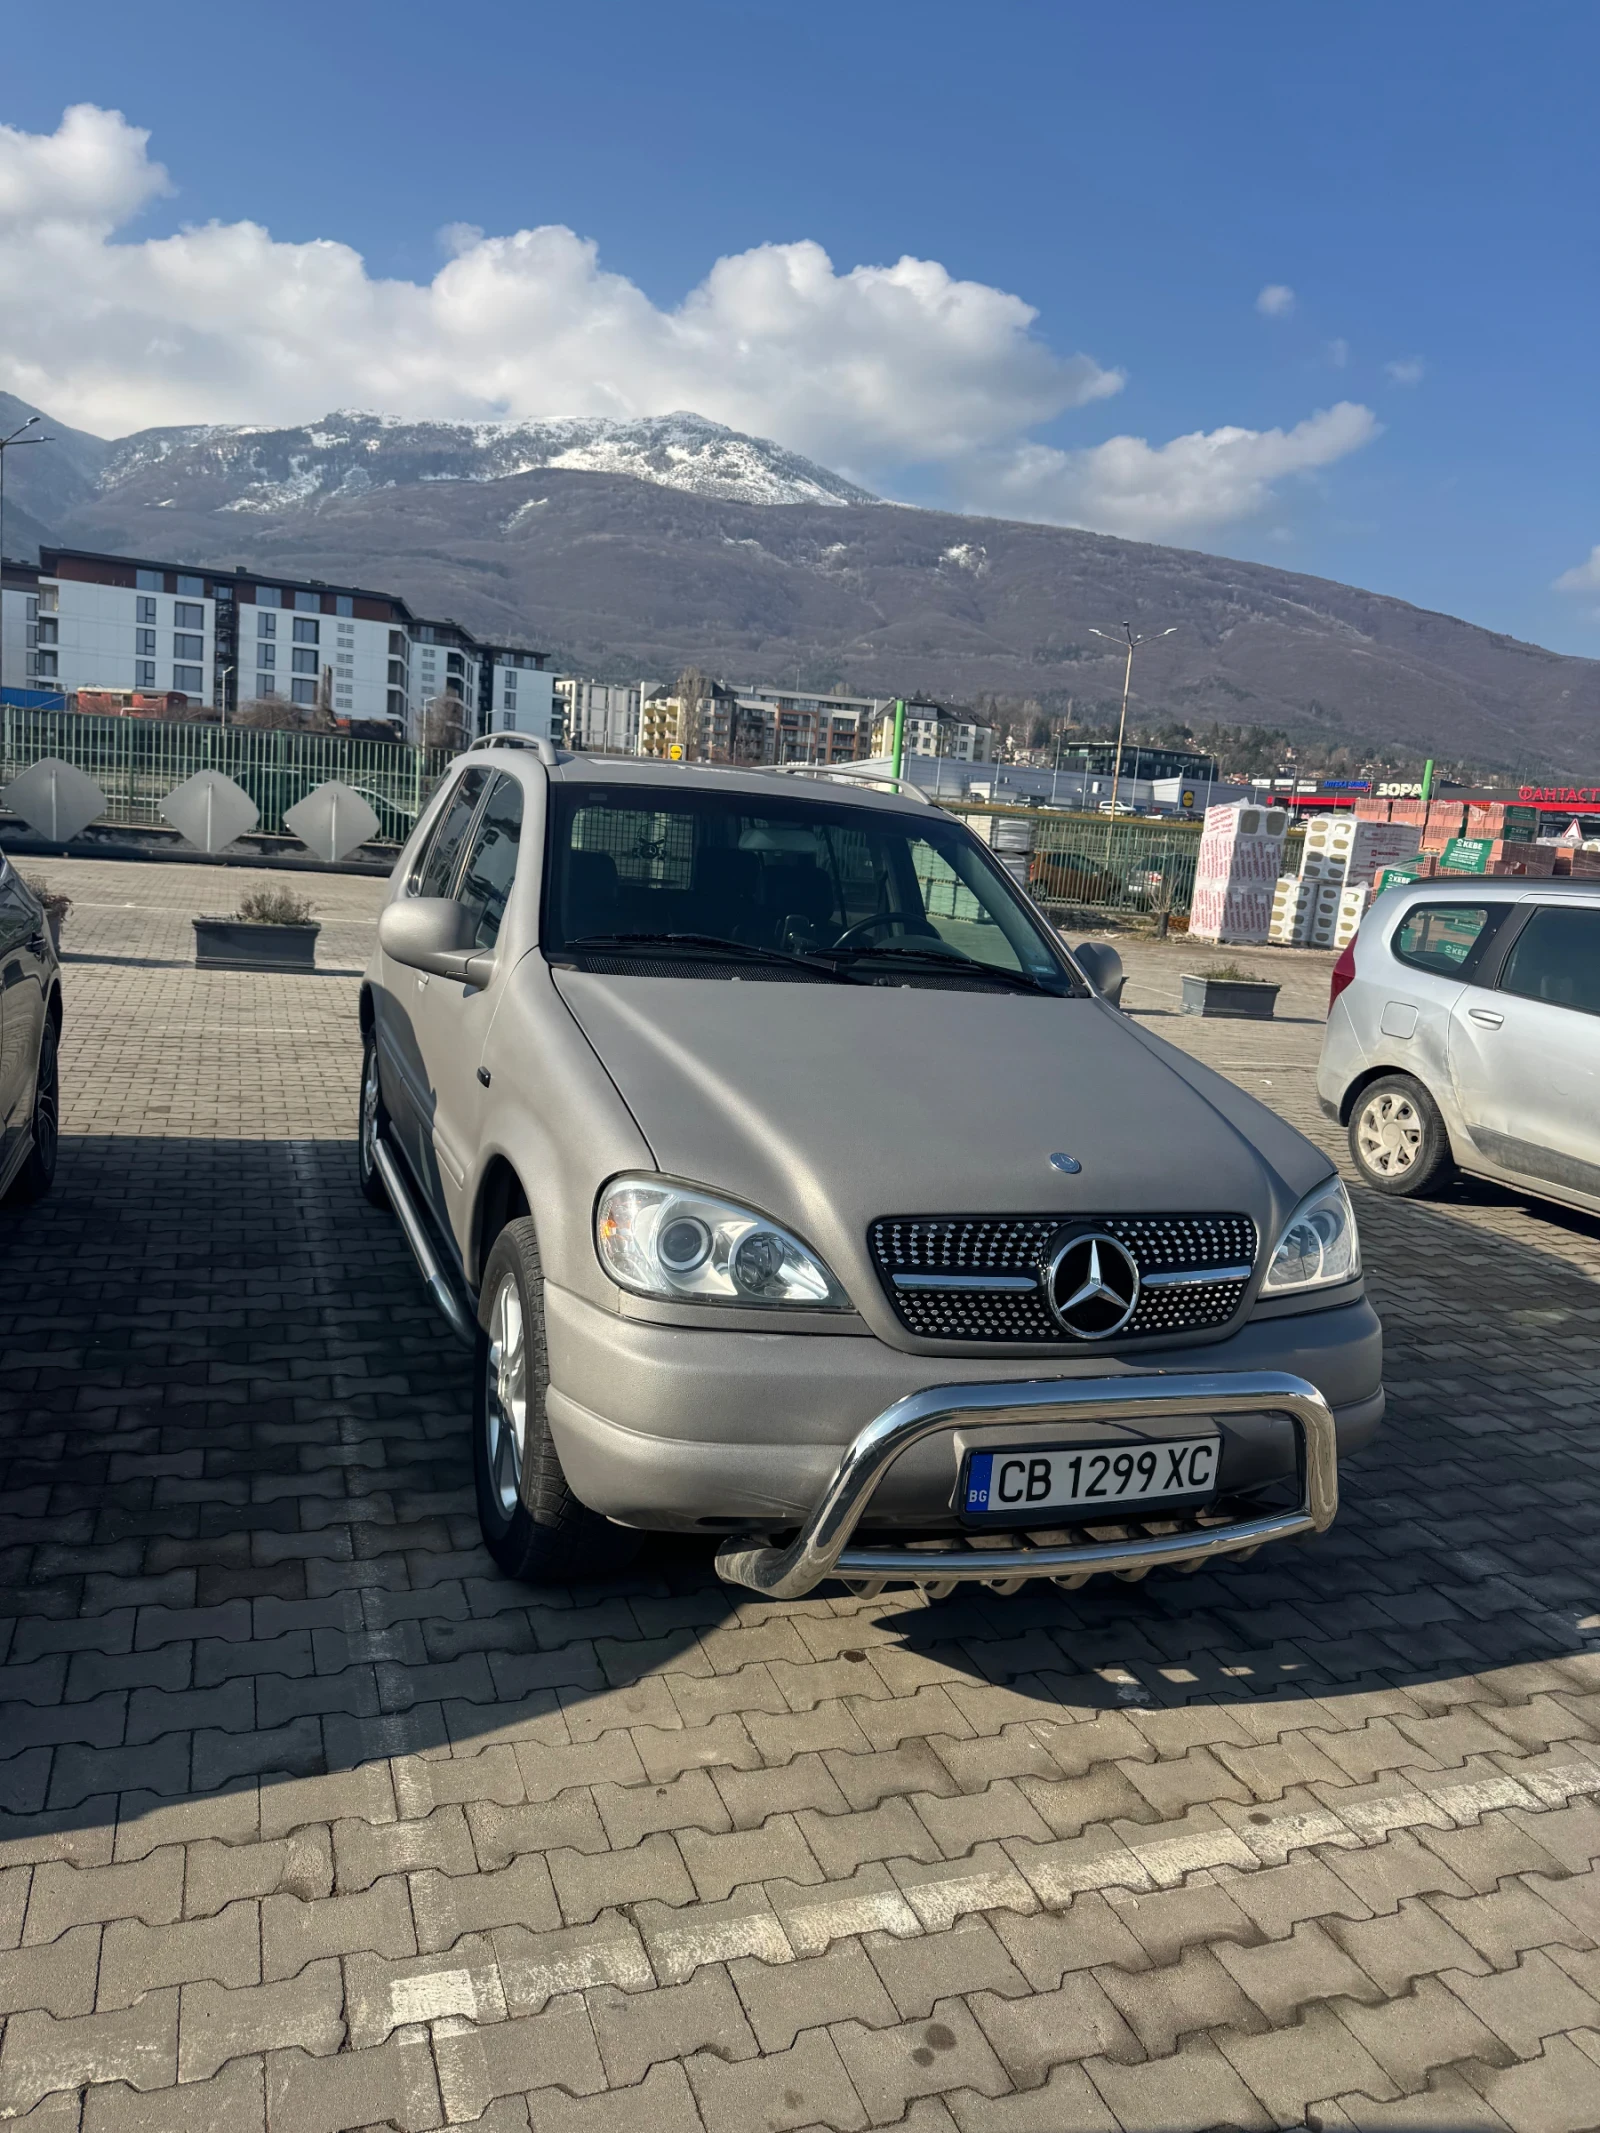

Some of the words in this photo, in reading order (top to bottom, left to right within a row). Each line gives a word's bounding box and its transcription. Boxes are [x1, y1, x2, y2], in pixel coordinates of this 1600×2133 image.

[1376, 783, 1423, 797] ЗОРА
[1518, 786, 1600, 802] ФАНТАСТ
[1463, 841, 1483, 850] KEBE
[998, 1458, 1051, 1502] CB
[1068, 1451, 1157, 1498] 1299
[1162, 1445, 1212, 1490] XC
[969, 1489, 987, 1503] BG
